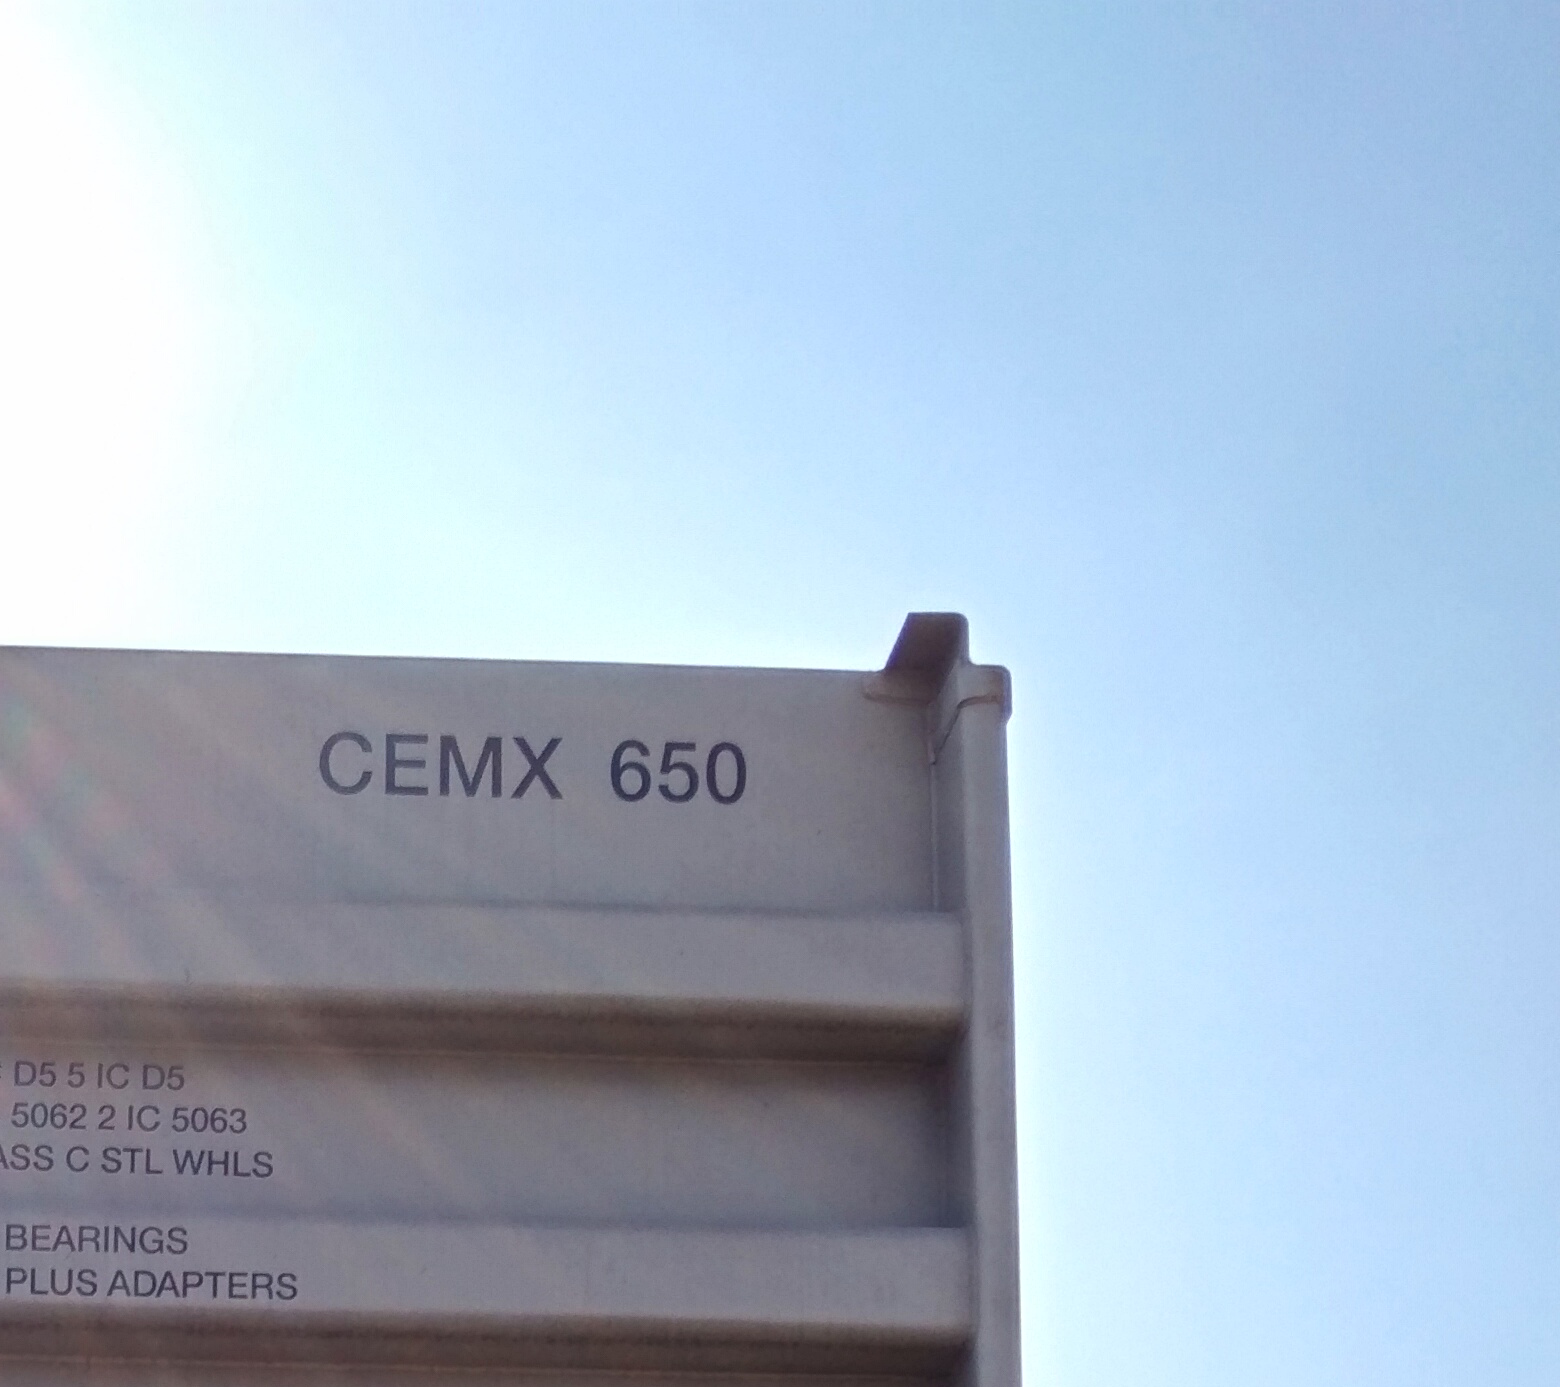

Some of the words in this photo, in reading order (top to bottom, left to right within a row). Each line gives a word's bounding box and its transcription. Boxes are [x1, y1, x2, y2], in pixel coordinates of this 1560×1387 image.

[318, 732, 563, 800] CEMX
[610, 740, 747, 805] 650
[14, 1061, 57, 1088] D5
[67, 1063, 86, 1089] 5
[97, 1063, 130, 1090] IC
[142, 1064, 185, 1091] D5
[11, 1103, 87, 1130] 5062
[97, 1105, 116, 1131] 2
[127, 1105, 161, 1132] IC
[171, 1107, 247, 1134] 5063
[65, 1146, 90, 1173] C
[101, 1147, 163, 1175] STL
[172, 1150, 274, 1179] WHLS
[5, 1224, 188, 1255] BEARINGS
[6, 1268, 98, 1297] PLUS
[106, 1270, 298, 1300] ADAPTERS
